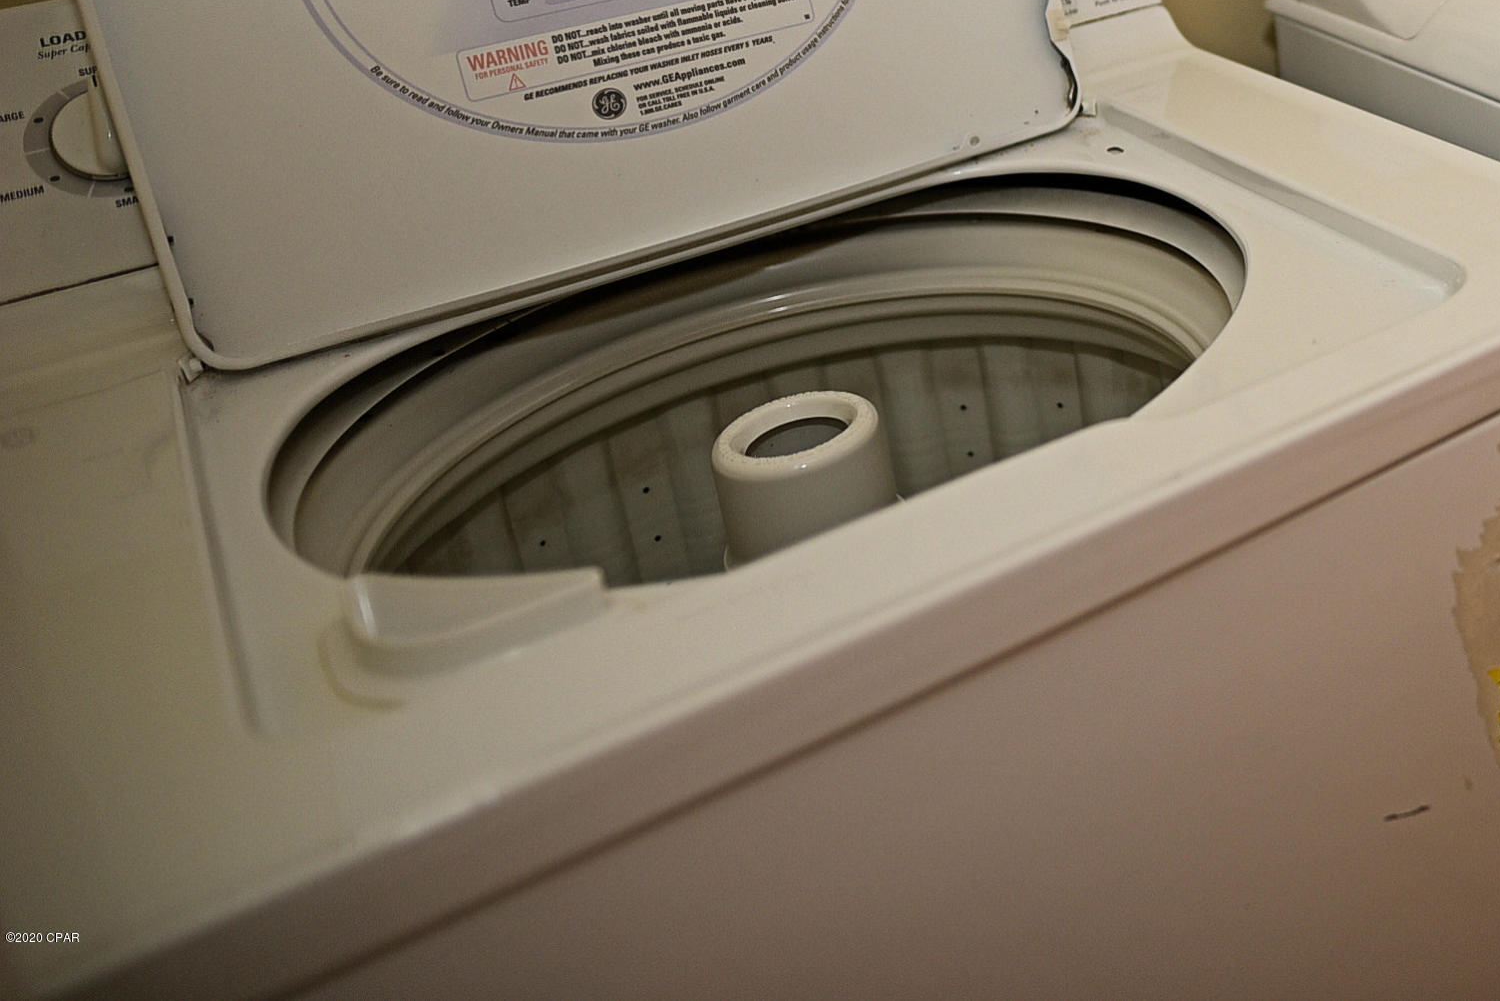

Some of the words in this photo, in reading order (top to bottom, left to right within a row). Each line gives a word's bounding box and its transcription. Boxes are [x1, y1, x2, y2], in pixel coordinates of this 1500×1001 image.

[40, 30, 86, 47] LOAD
[551, 34, 564, 44] DO
[608, 22, 623, 31] into
[624, 16, 651, 27] washer
[652, 10, 668, 21] until
[670, 8, 678, 17] all
[680, 4, 706, 15] moving
[707, 0, 724, 10] parts
[554, 44, 566, 54] DO
[610, 30, 635, 41] fabrics
[637, 25, 659, 35] soiled
[660, 21, 676, 31] with
[677, 11, 713, 26] flammable
[715, 6, 738, 18] liquids
[739, 4, 746, 12] or
[38, 49, 67, 60] Super
[466, 39, 549, 71] WARNING
[557, 55, 569, 64] DO
[607, 39, 637, 53] chlorine
[638, 34, 662, 46] bleach
[663, 29, 679, 40] with
[681, 22, 713, 36] ammonia
[722, 16, 743, 27] acids.
[475, 71, 488, 80] FOR
[489, 65, 524, 78] PERSONAL
[525, 58, 549, 69] SAFETY
[524, 92, 534, 101] GE
[535, 80, 588, 98] RECOMMENDS
[589, 70, 628, 85] REPLACING
[630, 65, 649, 75] YOUR
[650, 58, 680, 71] WASHER
[681, 54, 700, 63] INLET
[700, 47, 723, 58] HOSES
[724, 43, 744, 53] EVERY
[633, 58, 746, 91] www.GEAppliances.com
[370, 65, 382, 77] Be
[381, 75, 400, 89] sure
[399, 84, 408, 95] to
[408, 92, 430, 105] read
[428, 99, 445, 113] and
[444, 105, 470, 123] follow
[470, 117, 491, 128] your
[491, 120, 524, 134] Owners
[525, 126, 557, 138] Manual
[558, 129, 575, 139] that
[576, 131, 599, 139] came
[600, 127, 618, 137] with
[620, 127, 637, 138] your
[638, 123, 650, 133] GE
[682, 110, 699, 122] Also
[700, 102, 721, 116] follow
[722, 88, 751, 108] garment
[752, 79, 767, 92] care
[767, 69, 779, 82] and
[779, 52, 802, 75] product
[0, 185, 44, 203] MEDIUM
